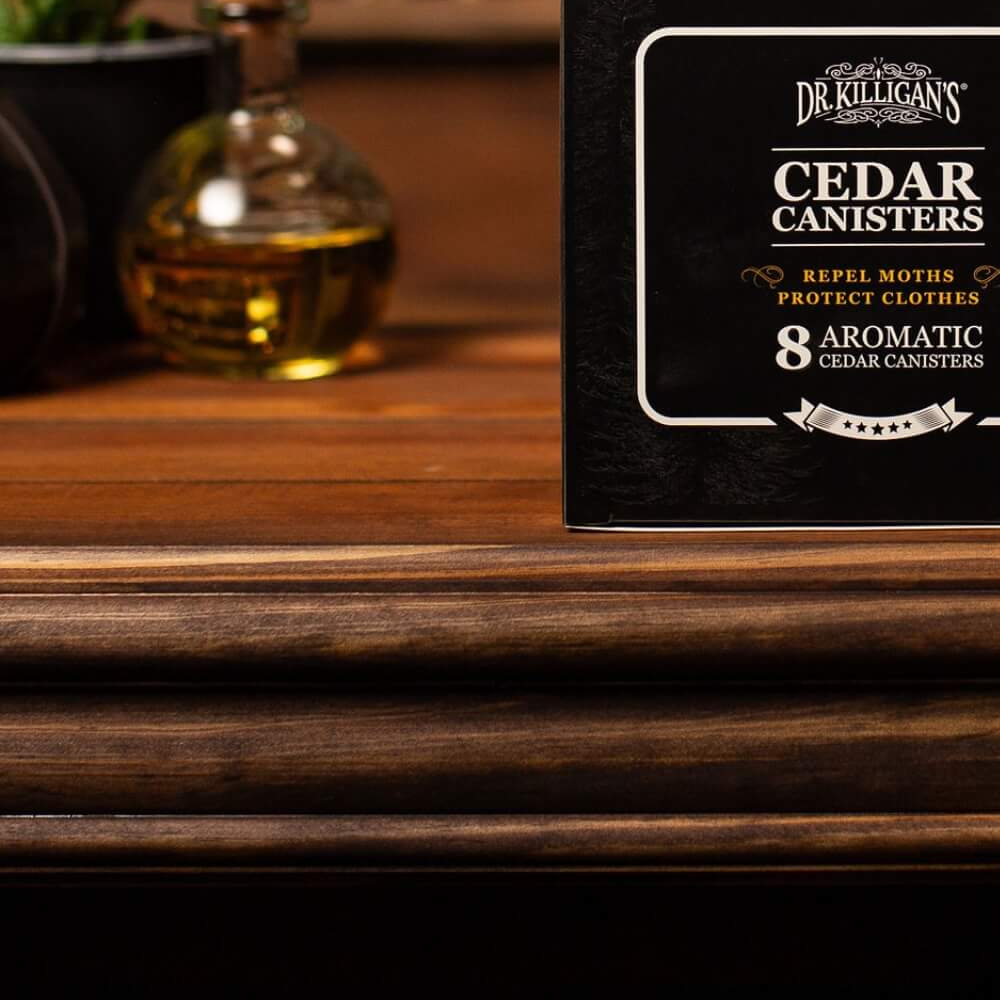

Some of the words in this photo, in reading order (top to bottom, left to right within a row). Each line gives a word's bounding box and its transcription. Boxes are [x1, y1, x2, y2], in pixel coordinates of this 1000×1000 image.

[773, 161, 982, 202] CEDAR
[771, 206, 984, 232] CANISTERS
[803, 268, 872, 283] REPEL
[878, 268, 955, 283] MOTHS
[777, 291, 875, 306] PROTECT
[881, 290, 980, 306] CLOTHES
[775, 325, 812, 370] 8
[818, 325, 984, 349] AROMATIC
[818, 353, 881, 369] CEDAR
[884, 353, 984, 369] CANISTERS
